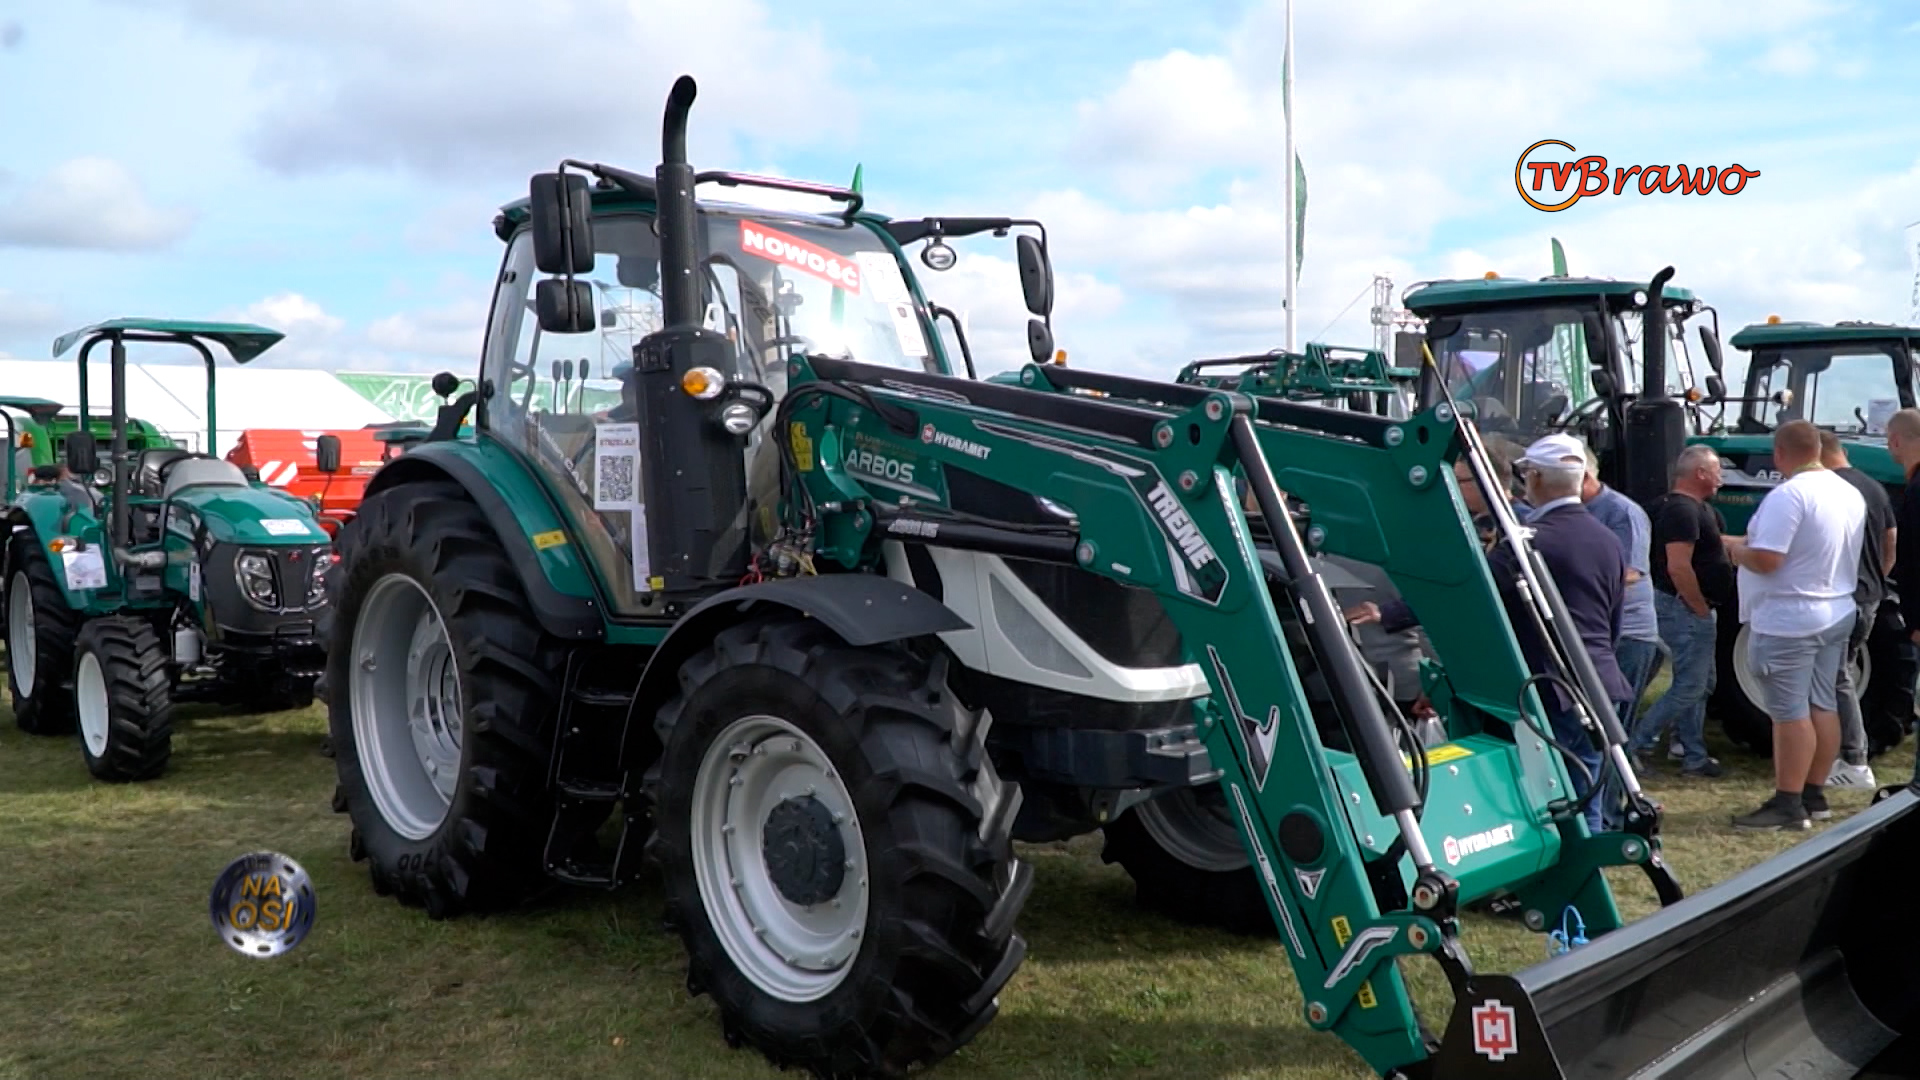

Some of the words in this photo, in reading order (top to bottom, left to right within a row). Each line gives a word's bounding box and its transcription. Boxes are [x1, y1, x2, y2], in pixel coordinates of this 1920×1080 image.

[743, 228, 859, 287] NOWOŚĆ
[933, 431, 992, 460] HYDRAMET
[845, 449, 915, 484] ARBOS
